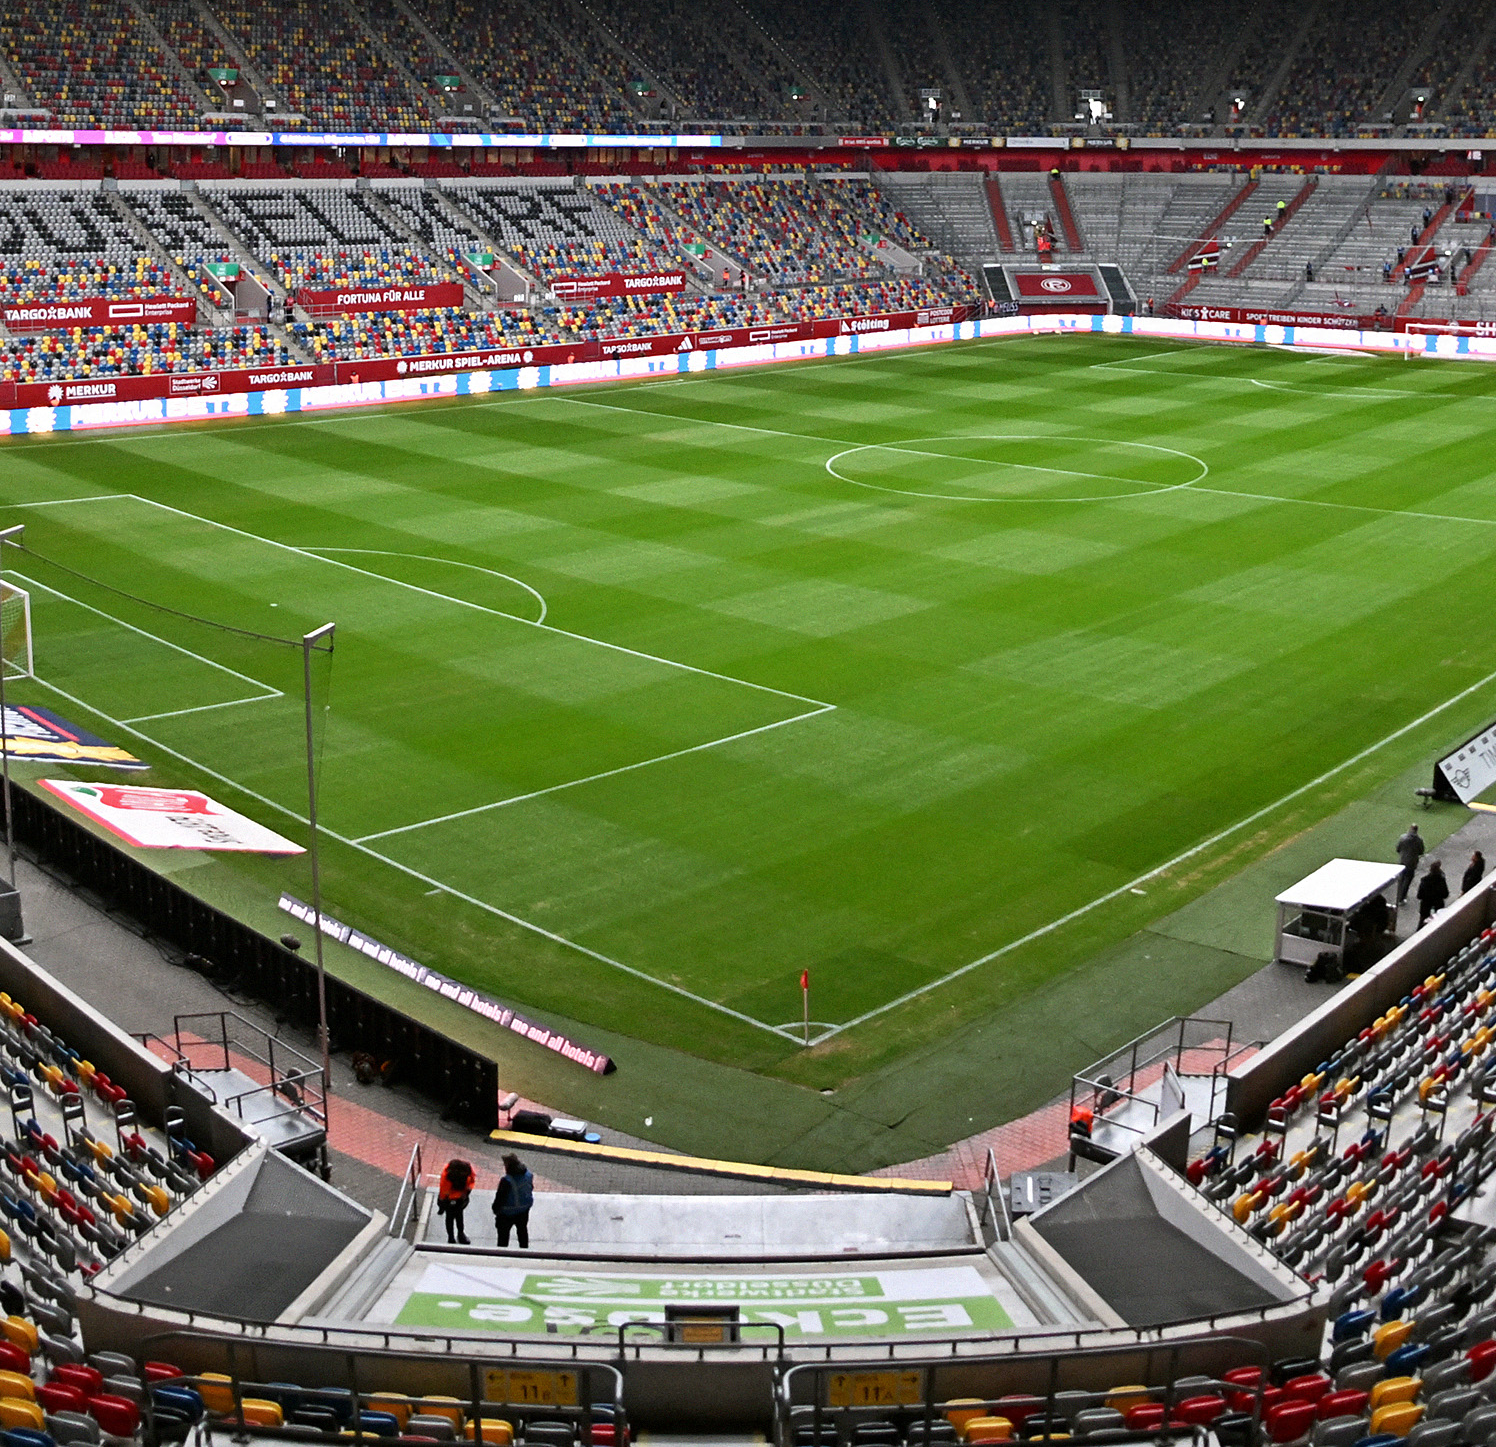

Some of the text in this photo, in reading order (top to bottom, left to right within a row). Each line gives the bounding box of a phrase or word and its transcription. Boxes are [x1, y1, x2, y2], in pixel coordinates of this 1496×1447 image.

[337, 289, 425, 305] FORTUNA FÜR ALLE
[1209, 309, 1230, 320] CARE
[1269, 314, 1295, 324] TREIBEN
[1297, 315, 1321, 325] KINDER
[851, 318, 889, 331] Stölting
[410, 353, 521, 372] MERKUR SPIEL-ARENA
[66, 384, 116, 398] MERKUR
[71, 393, 248, 424] MERKUR BETS
[425, 975, 502, 1021] me and all hotels
[510, 1017, 596, 1069] me and all hotels
